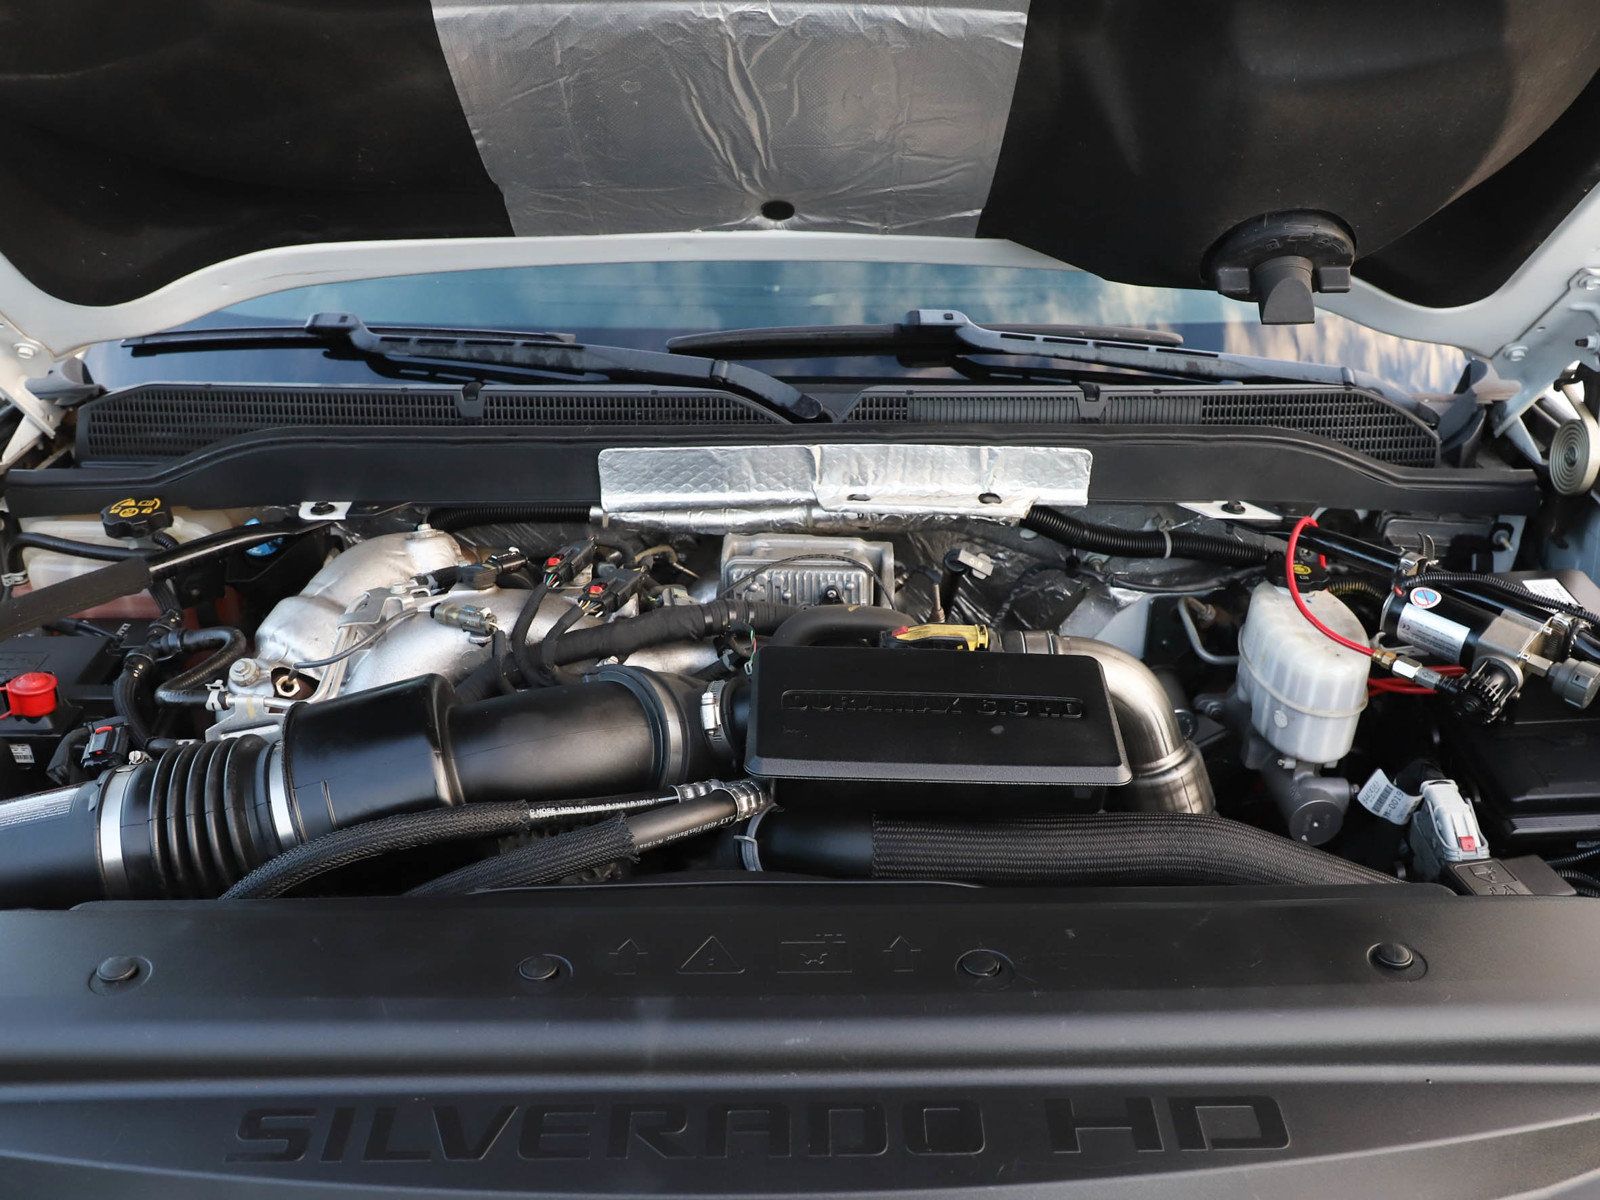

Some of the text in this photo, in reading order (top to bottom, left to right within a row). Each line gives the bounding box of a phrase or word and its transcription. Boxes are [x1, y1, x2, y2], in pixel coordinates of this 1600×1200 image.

[536, 807, 556, 817] HOSE
[224, 1096, 1292, 1163] SILVERADO HD
